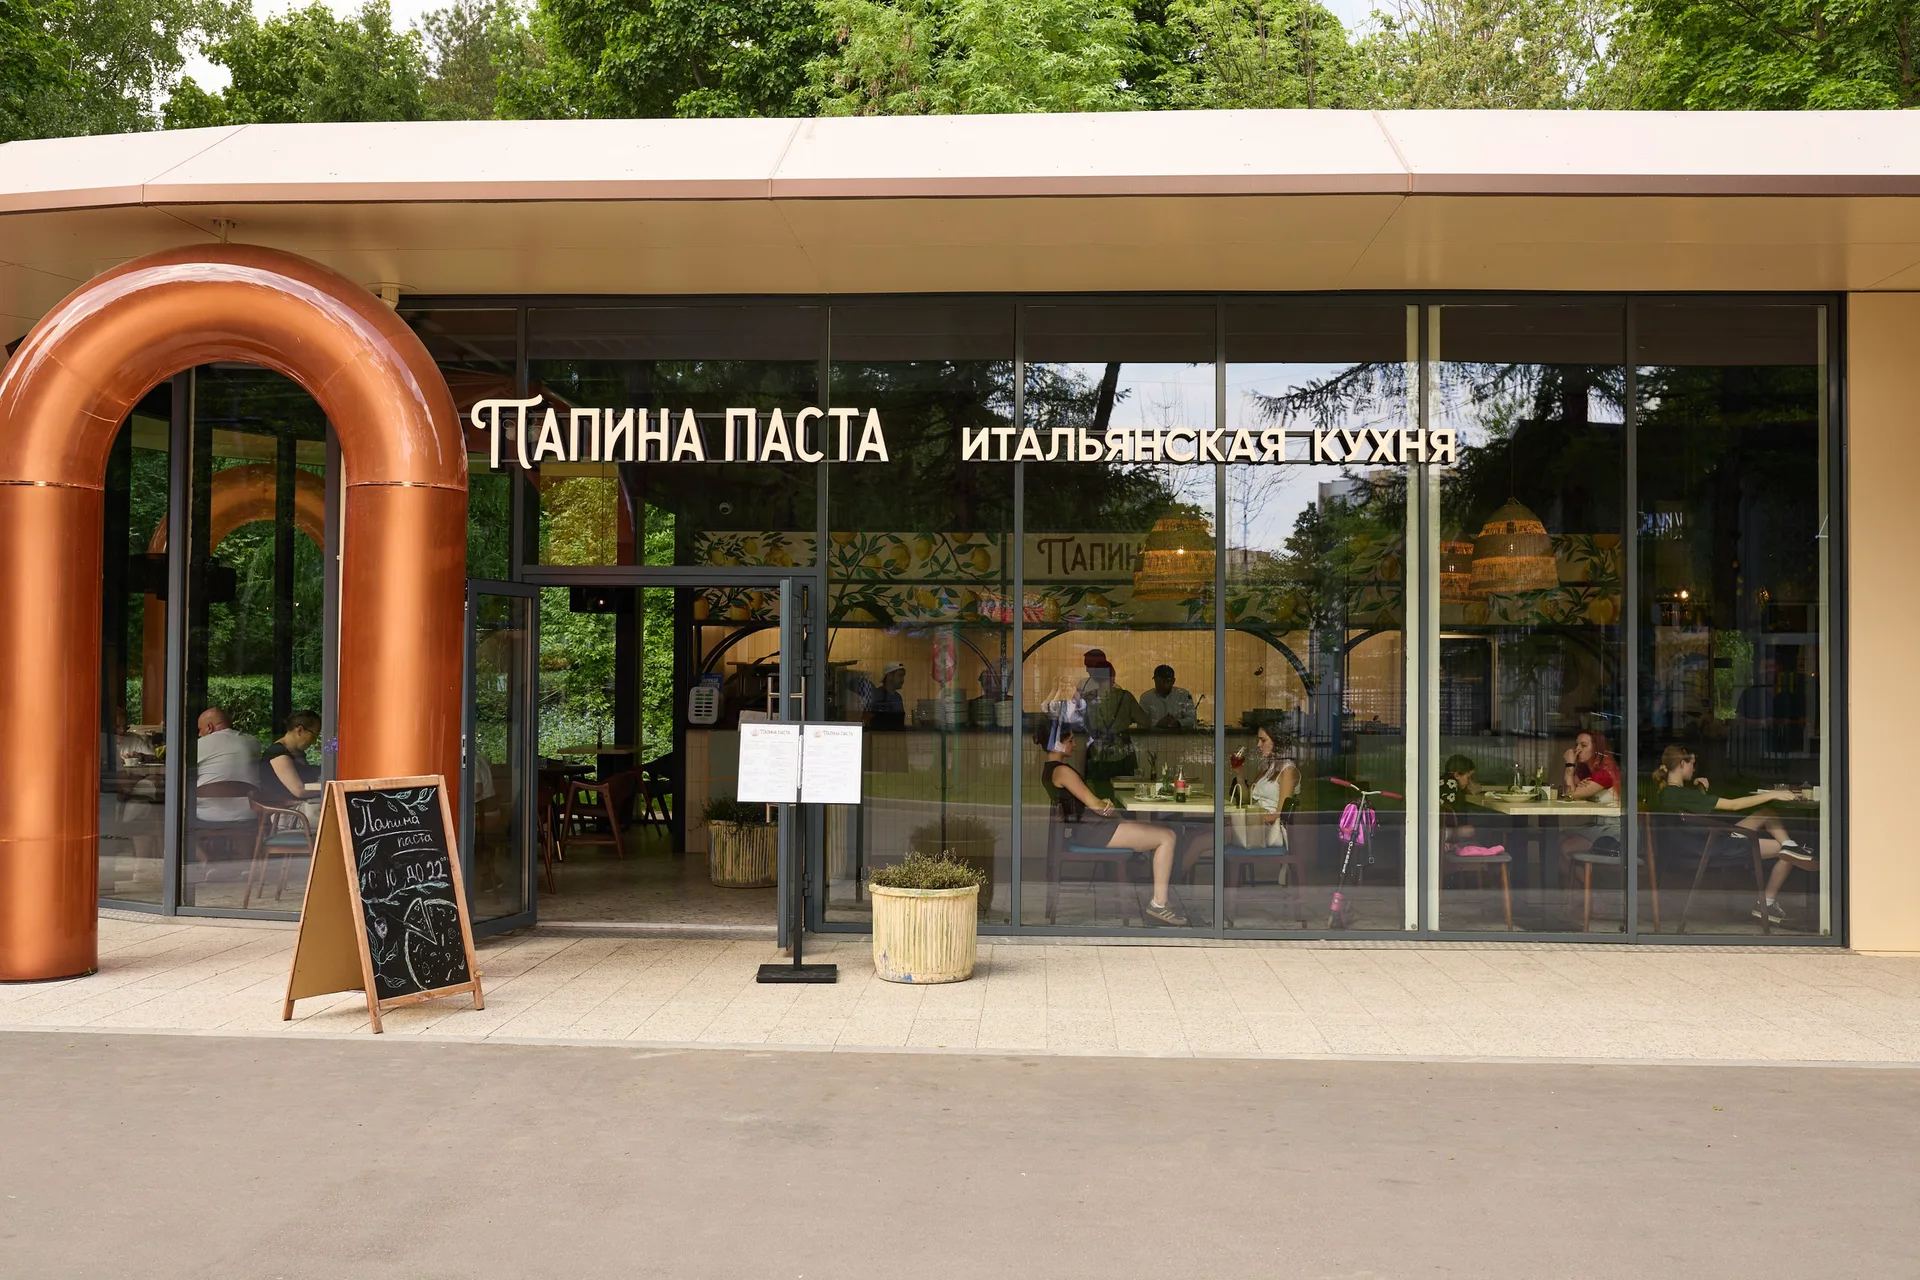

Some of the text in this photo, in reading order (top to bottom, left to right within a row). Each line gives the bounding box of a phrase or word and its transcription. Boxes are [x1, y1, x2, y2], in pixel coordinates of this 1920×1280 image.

[471, 394, 890, 470] ПАПИНА ПАСТА
[961, 426, 1457, 465] ИТАЛЬЯНСКАЯ КУХНЯ
[1037, 536, 1142, 575] ПАПИН
[351, 796, 421, 837] Папина
[397, 833, 433, 848] паста
[385, 868, 397, 888] 10
